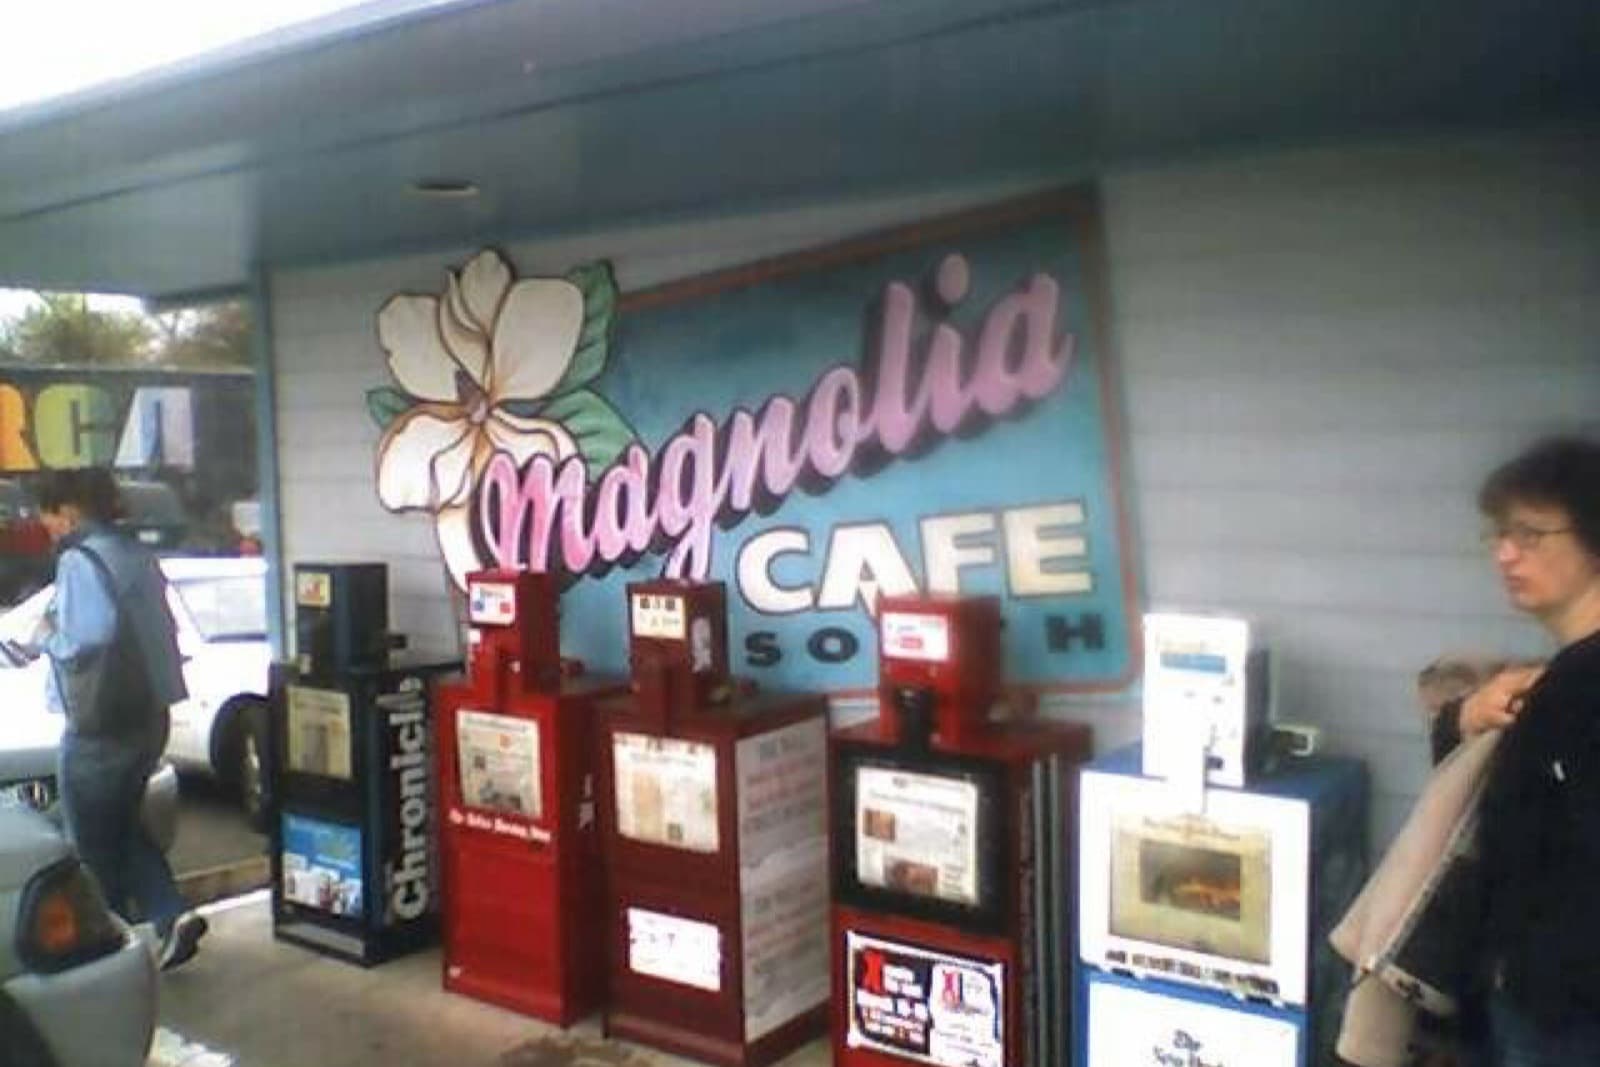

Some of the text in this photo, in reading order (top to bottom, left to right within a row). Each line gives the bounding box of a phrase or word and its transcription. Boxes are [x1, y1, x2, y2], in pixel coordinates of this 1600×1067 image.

[481, 253, 1074, 577] Magnolia
[736, 501, 1095, 616] CAFE
[744, 613, 1106, 667] SOH
